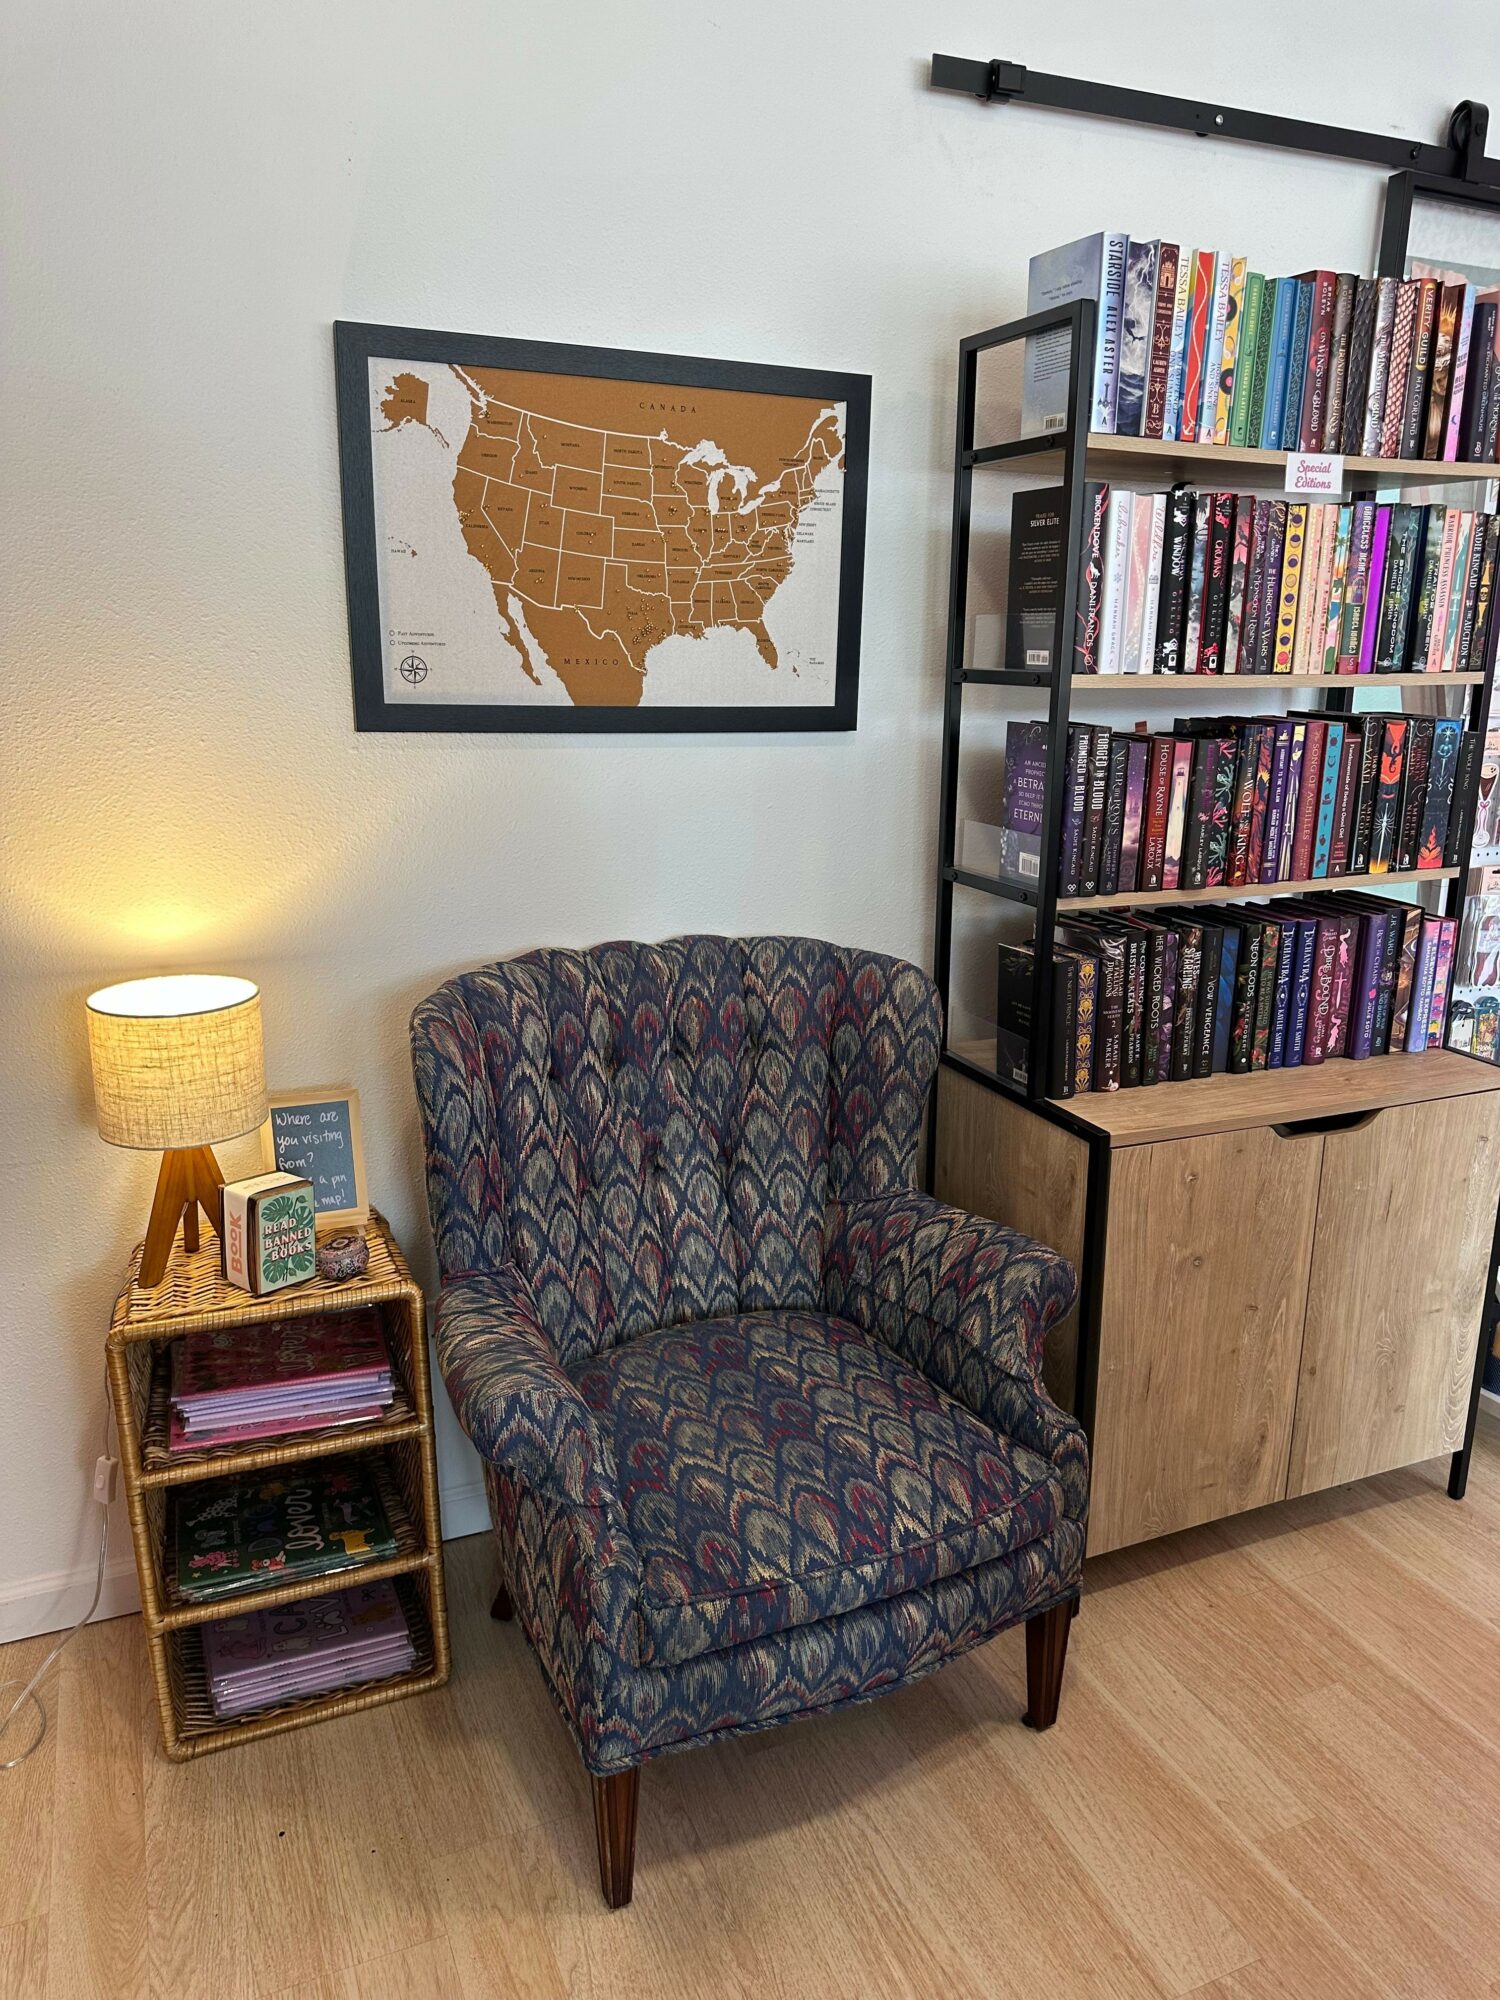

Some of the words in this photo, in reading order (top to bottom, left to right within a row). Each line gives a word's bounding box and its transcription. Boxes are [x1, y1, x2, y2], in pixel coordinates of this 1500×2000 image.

[1106, 241, 1123, 296] STARSIDE
[1179, 257, 1189, 295] TESSA
[1221, 262, 1230, 302] TESSA
[1105, 305, 1116, 332] ALEX
[1174, 298, 1186, 337] BAILEY
[1215, 305, 1226, 343] BAILEY
[1424, 289, 1434, 330] VERITY
[1320, 333, 1325, 345] ON
[1418, 333, 1429, 365] GUILD
[1103, 339, 1115, 374] ASTER
[1315, 345, 1324, 376] WINGS
[1337, 349, 1346, 377] BOND
[1375, 349, 1385, 382] WINGS
[1482, 349, 1490, 388] ENCHANTED
[639, 402, 697, 414] CANADA
[1165, 369, 1174, 414] SUMMER
[1206, 382, 1214, 410] SINKER
[1310, 390, 1321, 432] BLOOD
[1329, 398, 1341, 433] BURNS
[1370, 400, 1380, 430] BIND
[1409, 393, 1420, 435] CORLAND
[1478, 388, 1488, 432] GREENHOUSE
[1489, 404, 1499, 443] MORNING
[1295, 475, 1332, 489] Editions
[1297, 460, 1332, 477] Special
[1030, 519, 1046, 527] SILVER
[1047, 518, 1060, 526] ELITE
[1092, 494, 1102, 531] BROKEN
[1361, 506, 1372, 550] GRACELESS
[1091, 531, 1100, 558] DOVE
[1474, 526, 1483, 552] SADIE
[1171, 536, 1183, 576] WINDOW
[1212, 539, 1223, 578] CROWNS
[1444, 546, 1452, 577] PRINCESS
[1470, 554, 1478, 588] KINCAID
[1390, 560, 1399, 589] DANIELLE
[1396, 559, 1404, 599] BRIDGE
[1426, 560, 1434, 589] DANIELLE
[1089, 582, 1097, 605] DANI
[1251, 575, 1260, 619] MONSOON
[1265, 576, 1276, 628] HURRICANE
[1439, 579, 1447, 608] ASSASSIN
[1086, 606, 1096, 646] FRANCIS
[1169, 591, 1177, 634] GILLIG
[1210, 594, 1218, 637] GILLIG
[1389, 603, 1399, 653] KINGDOM
[1261, 629, 1270, 657] WARS
[1424, 615, 1432, 652] QUEEN
[1461, 620, 1471, 656] AUCTION
[1076, 734, 1089, 774] PROMISED
[1096, 733, 1110, 767] FORGED
[1159, 744, 1170, 777] HOUSE
[1312, 743, 1320, 769] SONG
[1345, 743, 1355, 783] Fundamentals
[1017, 777, 1044, 792] BETRA
[1073, 785, 1085, 812] BLOOD
[1091, 780, 1106, 810] BLOOD
[1155, 786, 1165, 816] RAYNE
[1241, 779, 1253, 817] WOLF
[1013, 808, 1043, 824] ETERNI
[1108, 799, 1121, 835] ROSES
[1303, 793, 1314, 841] ACHILLES
[1070, 847, 1078, 875] KINCAID
[1088, 847, 1096, 873] KINCAID
[1146, 837, 1155, 869] LAROUX
[1154, 837, 1163, 868] HARLEY
[1235, 833, 1246, 865] KING
[1129, 943, 1137, 979] BRISTOL
[1250, 937, 1260, 967] NEON
[1278, 926, 1294, 984] ENCHANTRA
[1299, 927, 1315, 983] ENCHANTRA
[1322, 944, 1335, 972] DIRE
[1387, 933, 1395, 956] WARD
[1106, 962, 1114, 998] DRAGONS
[1153, 957, 1163, 992] WICKED
[1182, 948, 1195, 989] STARLING
[1247, 970, 1256, 997] GODS
[1372, 956, 1380, 985] CHAINS
[1425, 944, 1435, 998] ELSEWHERE
[1127, 984, 1135, 1014] KEATS
[1206, 978, 1215, 1004] VOW
[1319, 976, 1332, 1015] BOUND
[1151, 995, 1160, 1029] ROOTS
[1420, 1001, 1428, 1034] EXPRESS
[1202, 1005, 1212, 1055] VENGEANCE
[1294, 1030, 1302, 1051] SMITH
[275, 1112, 312, 1126] Where
[320, 1111, 339, 1123] are
[277, 1135, 299, 1153] you
[302, 1129, 344, 1149] visiting
[278, 1151, 314, 1171] from?
[319, 1175, 328, 1184] a
[331, 1174, 347, 1189] pin
[321, 1189, 347, 1206] map!
[230, 1211, 243, 1274] BOOK
[264, 1218, 296, 1235] READ
[264, 1228, 312, 1249] BANNED
[271, 1242, 312, 1261] BOOKS
[284, 1489, 325, 1551] lover
[268, 1603, 308, 1636] CA
